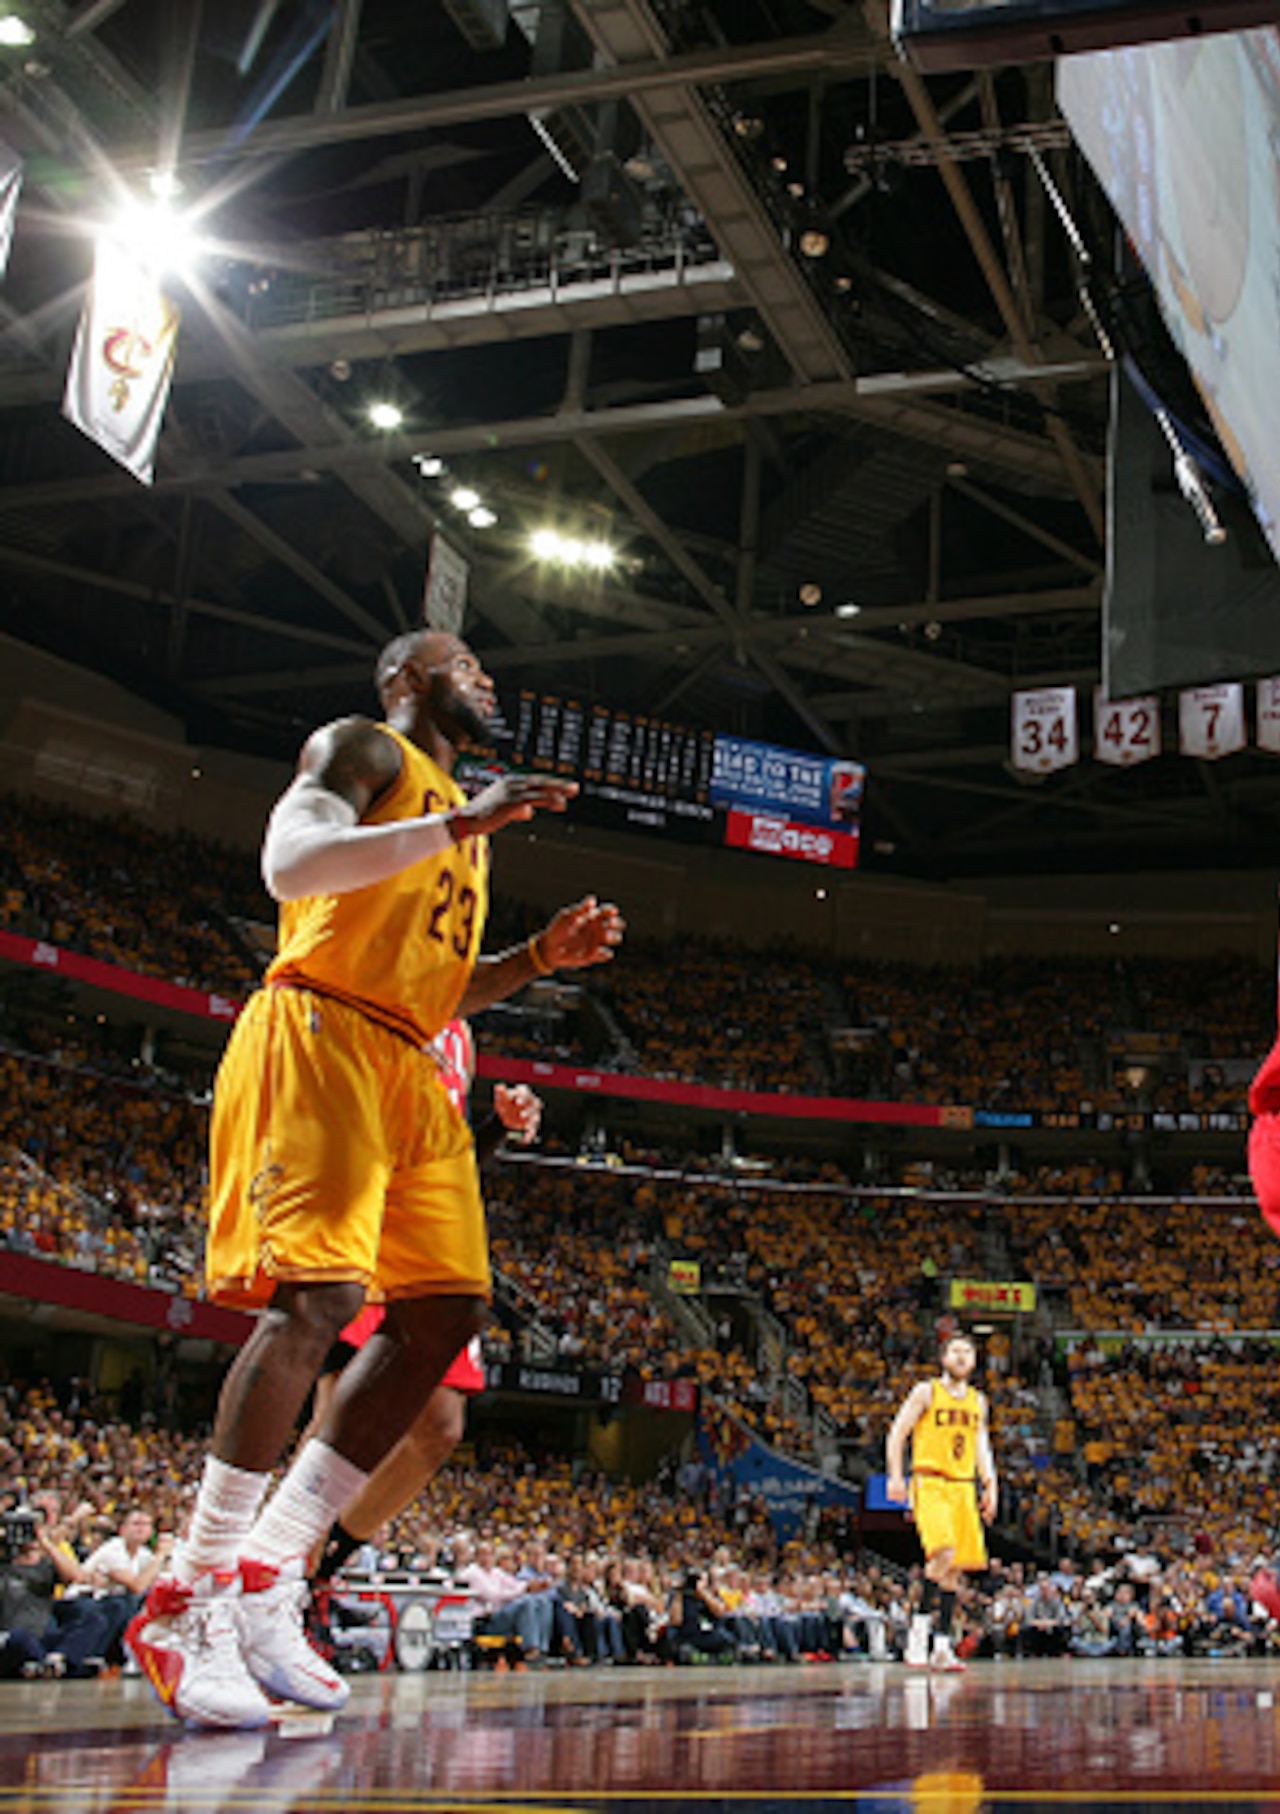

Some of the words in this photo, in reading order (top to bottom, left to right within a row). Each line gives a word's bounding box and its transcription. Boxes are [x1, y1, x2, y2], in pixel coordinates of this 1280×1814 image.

[1021, 715, 1068, 755] 34
[1103, 710, 1150, 746] 42
[1202, 702, 1222, 741] 7
[427, 867, 479, 960] 23
